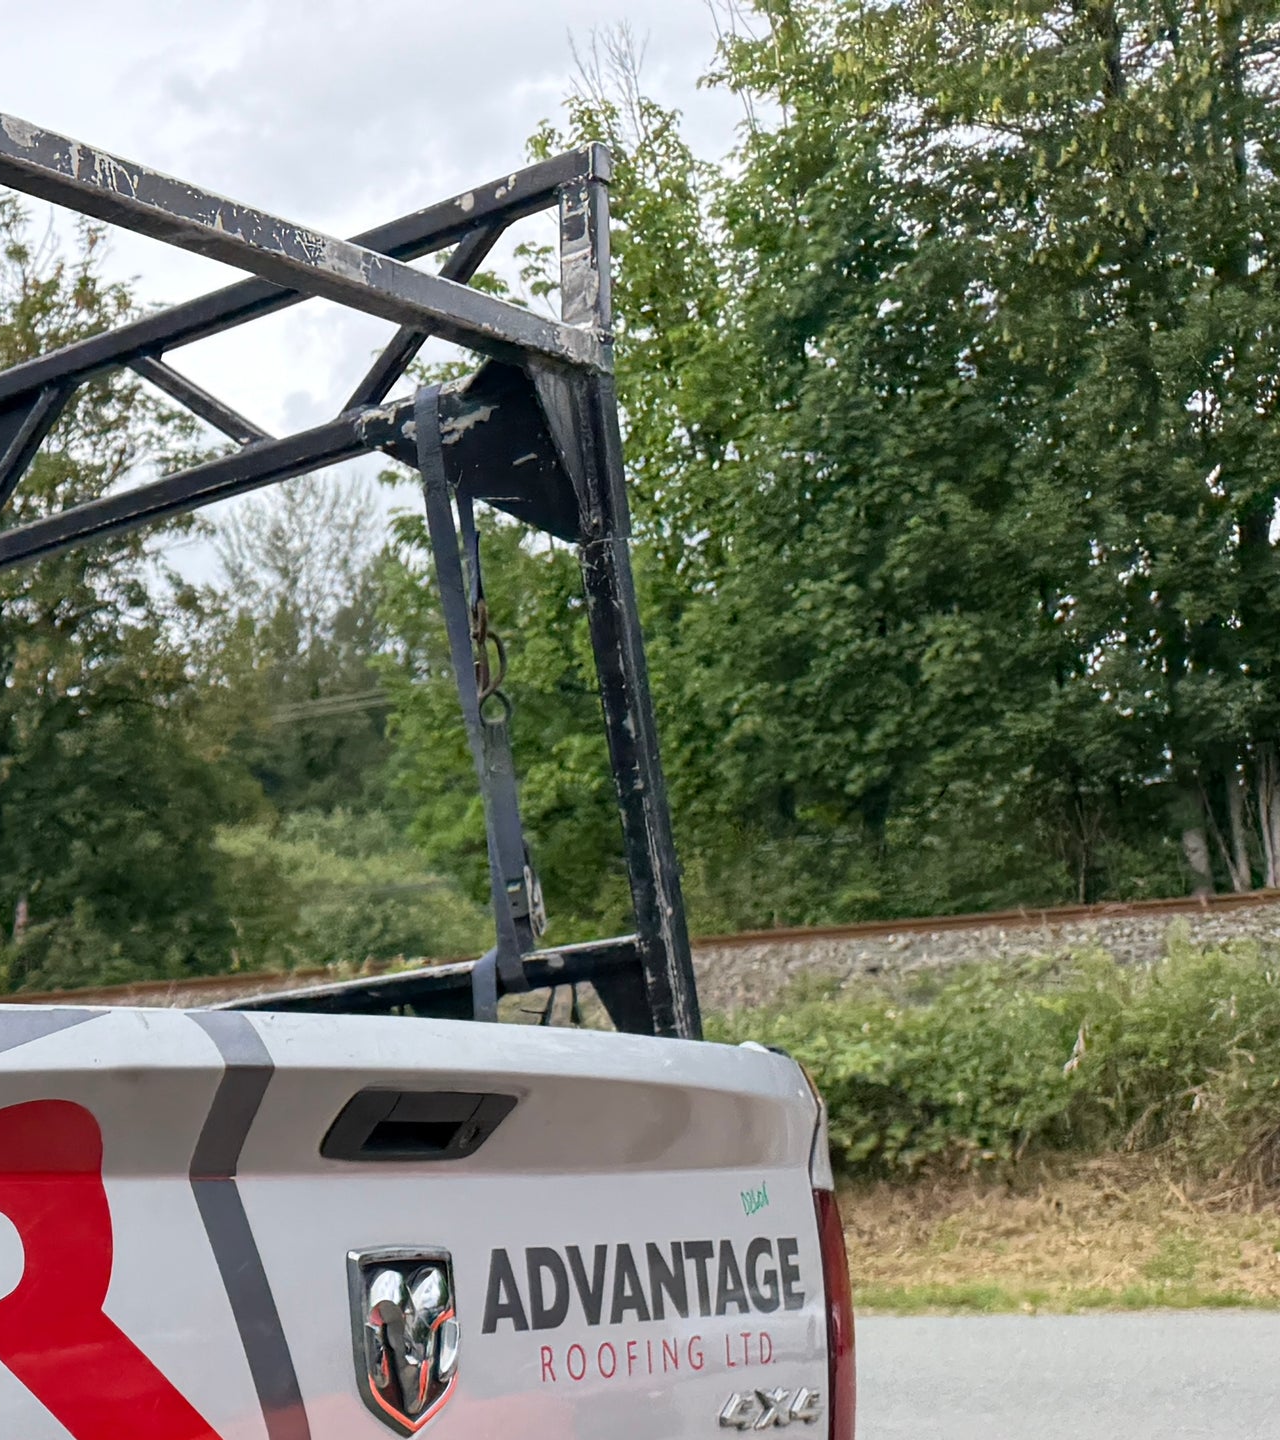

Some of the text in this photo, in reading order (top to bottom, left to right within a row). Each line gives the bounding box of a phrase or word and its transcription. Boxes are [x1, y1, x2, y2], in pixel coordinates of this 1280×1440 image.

[482, 1237, 806, 1335] ADVANTAGE
[541, 1332, 777, 1383] ROOFING LTD.
